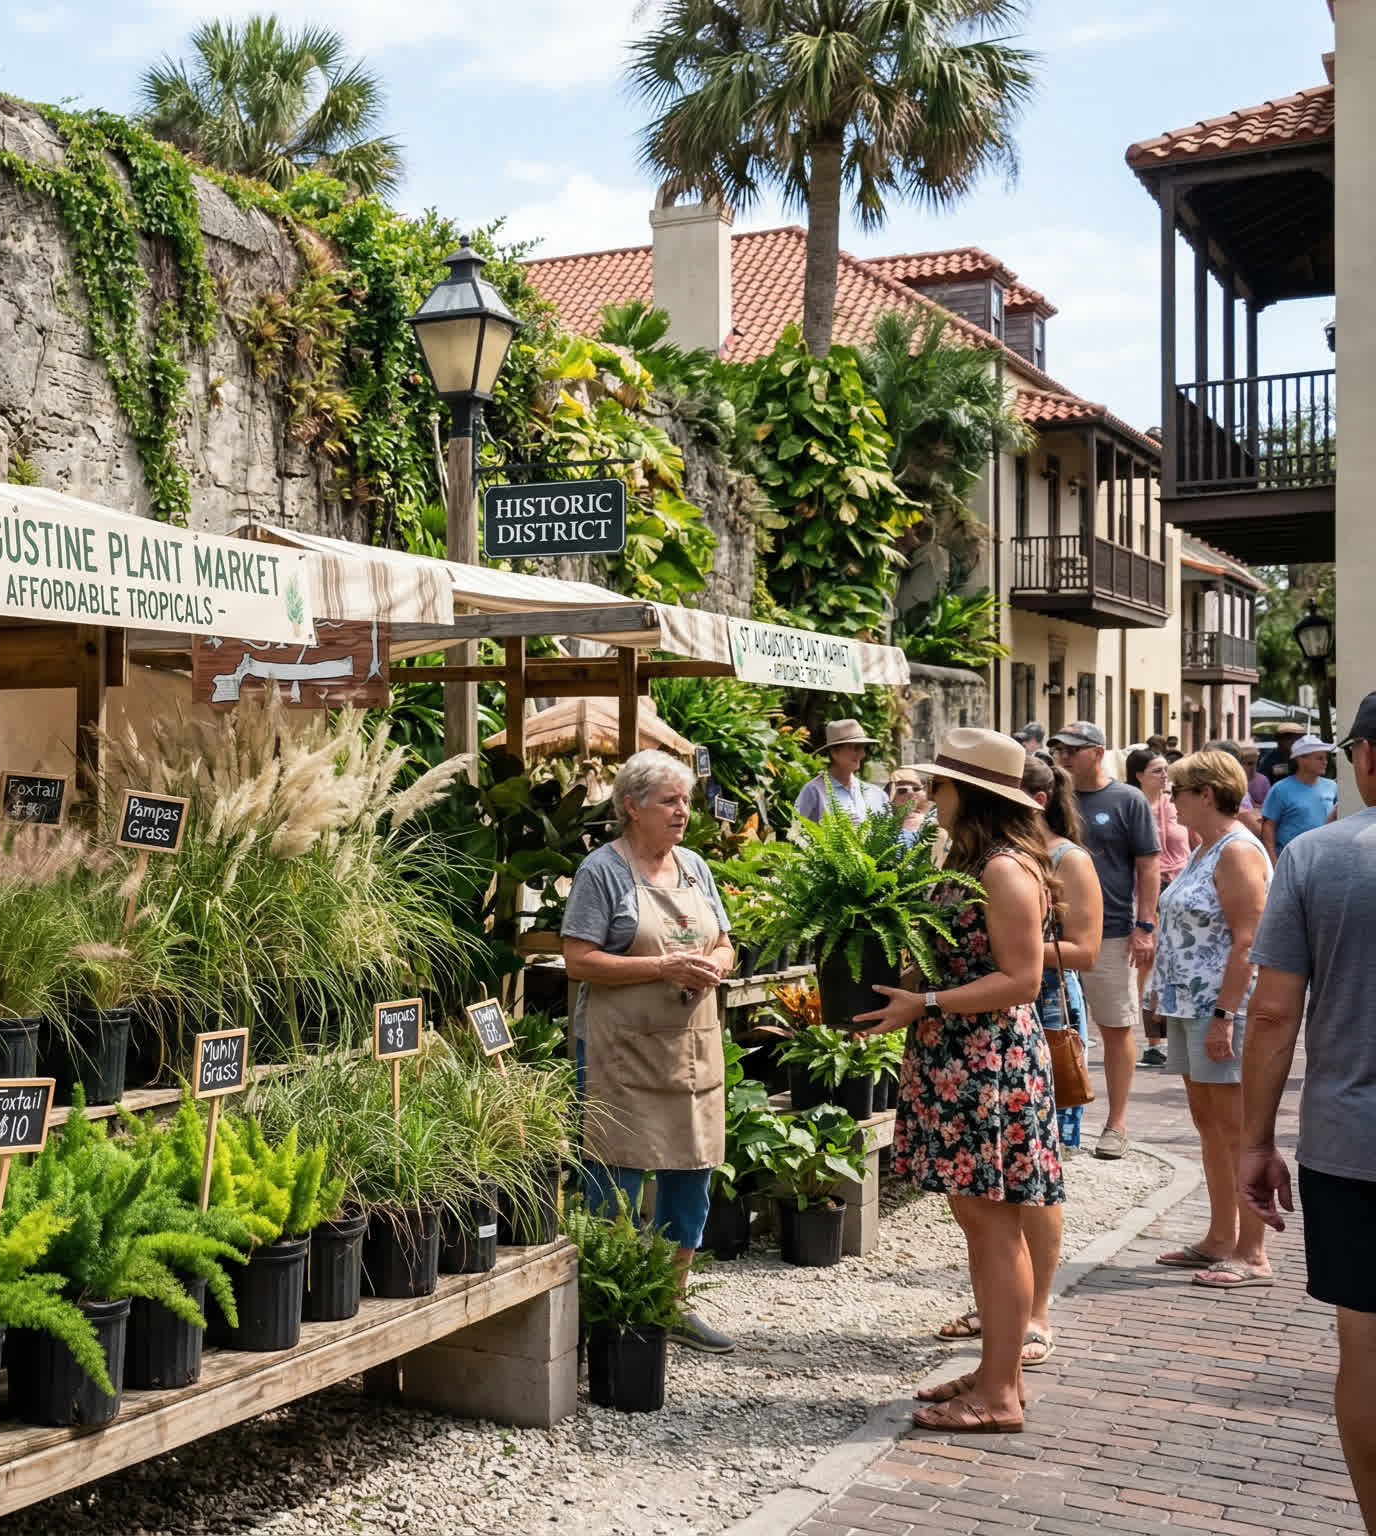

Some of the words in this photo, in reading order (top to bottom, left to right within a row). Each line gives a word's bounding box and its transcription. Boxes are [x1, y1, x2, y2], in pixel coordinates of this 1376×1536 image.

[495, 493, 613, 519] HISTORIC
[497, 519, 612, 544] DISTRICT
[107, 530, 184, 584] PLANT
[192, 544, 280, 597] MARKET
[6, 573, 121, 617] AFFORDABLE
[126, 587, 214, 626] TROPICALS
[7, 778, 61, 800] Foxtail
[128, 797, 180, 825] Pampas
[127, 819, 170, 842] Grass
[201, 1038, 240, 1062] Muhly
[202, 1062, 238, 1085] Grass
